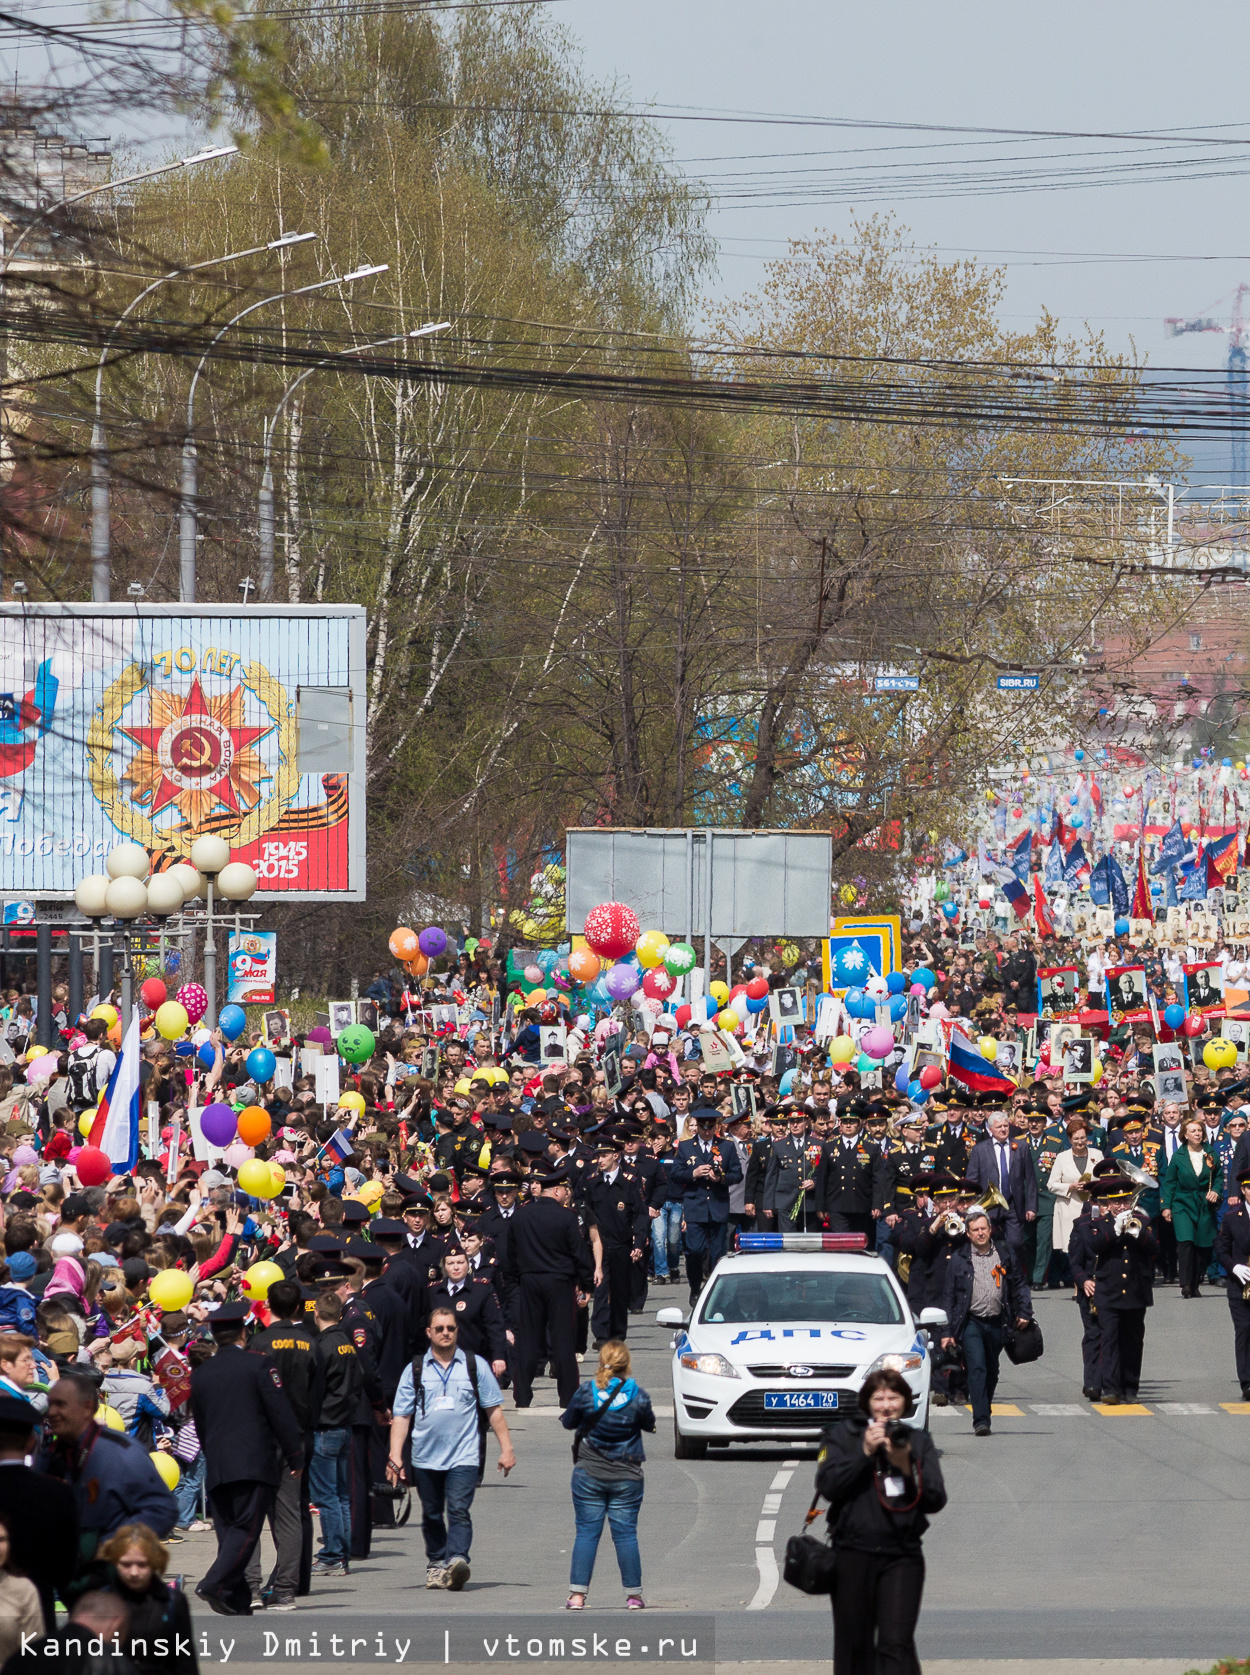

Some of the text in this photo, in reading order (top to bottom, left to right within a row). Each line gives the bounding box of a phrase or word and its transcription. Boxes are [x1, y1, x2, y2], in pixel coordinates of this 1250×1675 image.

[152, 647, 241, 679] 70 ЛЕТ
[1000, 678, 1036, 687] SIBR.RU
[262, 841, 307, 860] 1945
[252, 859, 299, 878] 2015
[235, 955, 267, 977] 9 мая
[731, 1329, 867, 1345] ДПС
[783, 1393, 814, 1407] 1464
[821, 1392, 834, 1403] 70
